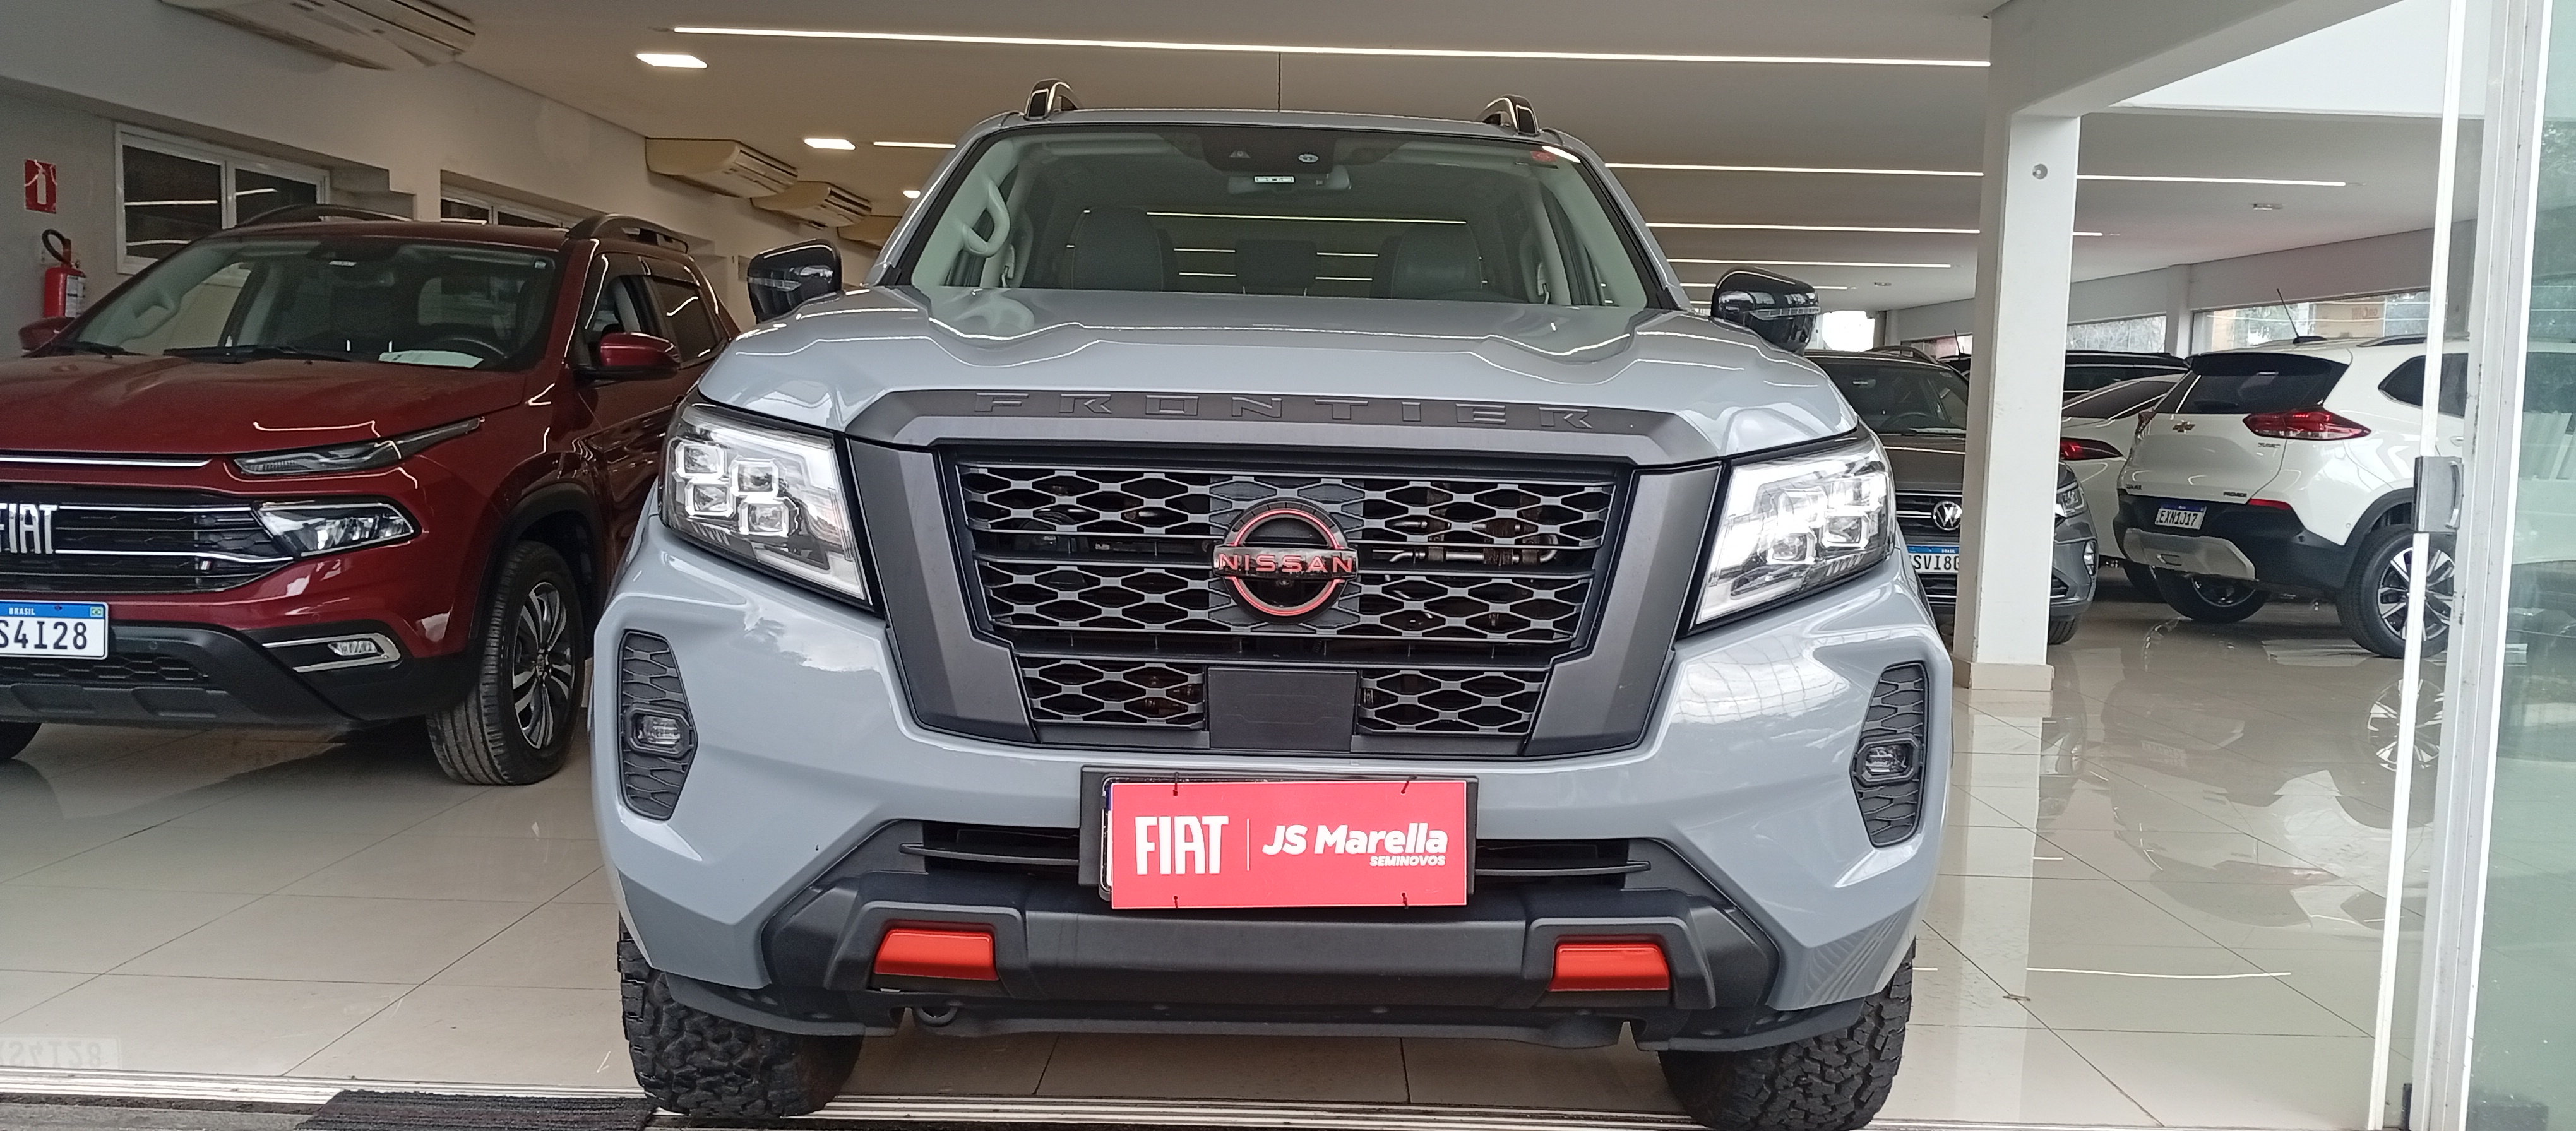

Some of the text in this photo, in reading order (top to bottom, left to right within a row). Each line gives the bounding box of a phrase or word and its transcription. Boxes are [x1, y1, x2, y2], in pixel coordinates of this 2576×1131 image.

[975, 392, 1593, 429] FRONTIER
[2159, 510, 2198, 526] EXN1J17
[1219, 553, 1353, 574] NISSAN
[8, 607, 36, 616] BRASIL
[0, 619, 87, 650] S4I28
[1135, 815, 1229, 875] FIAT
[1261, 822, 1448, 856] JS Marella
[1369, 855, 1446, 867] SEMINOVOS
